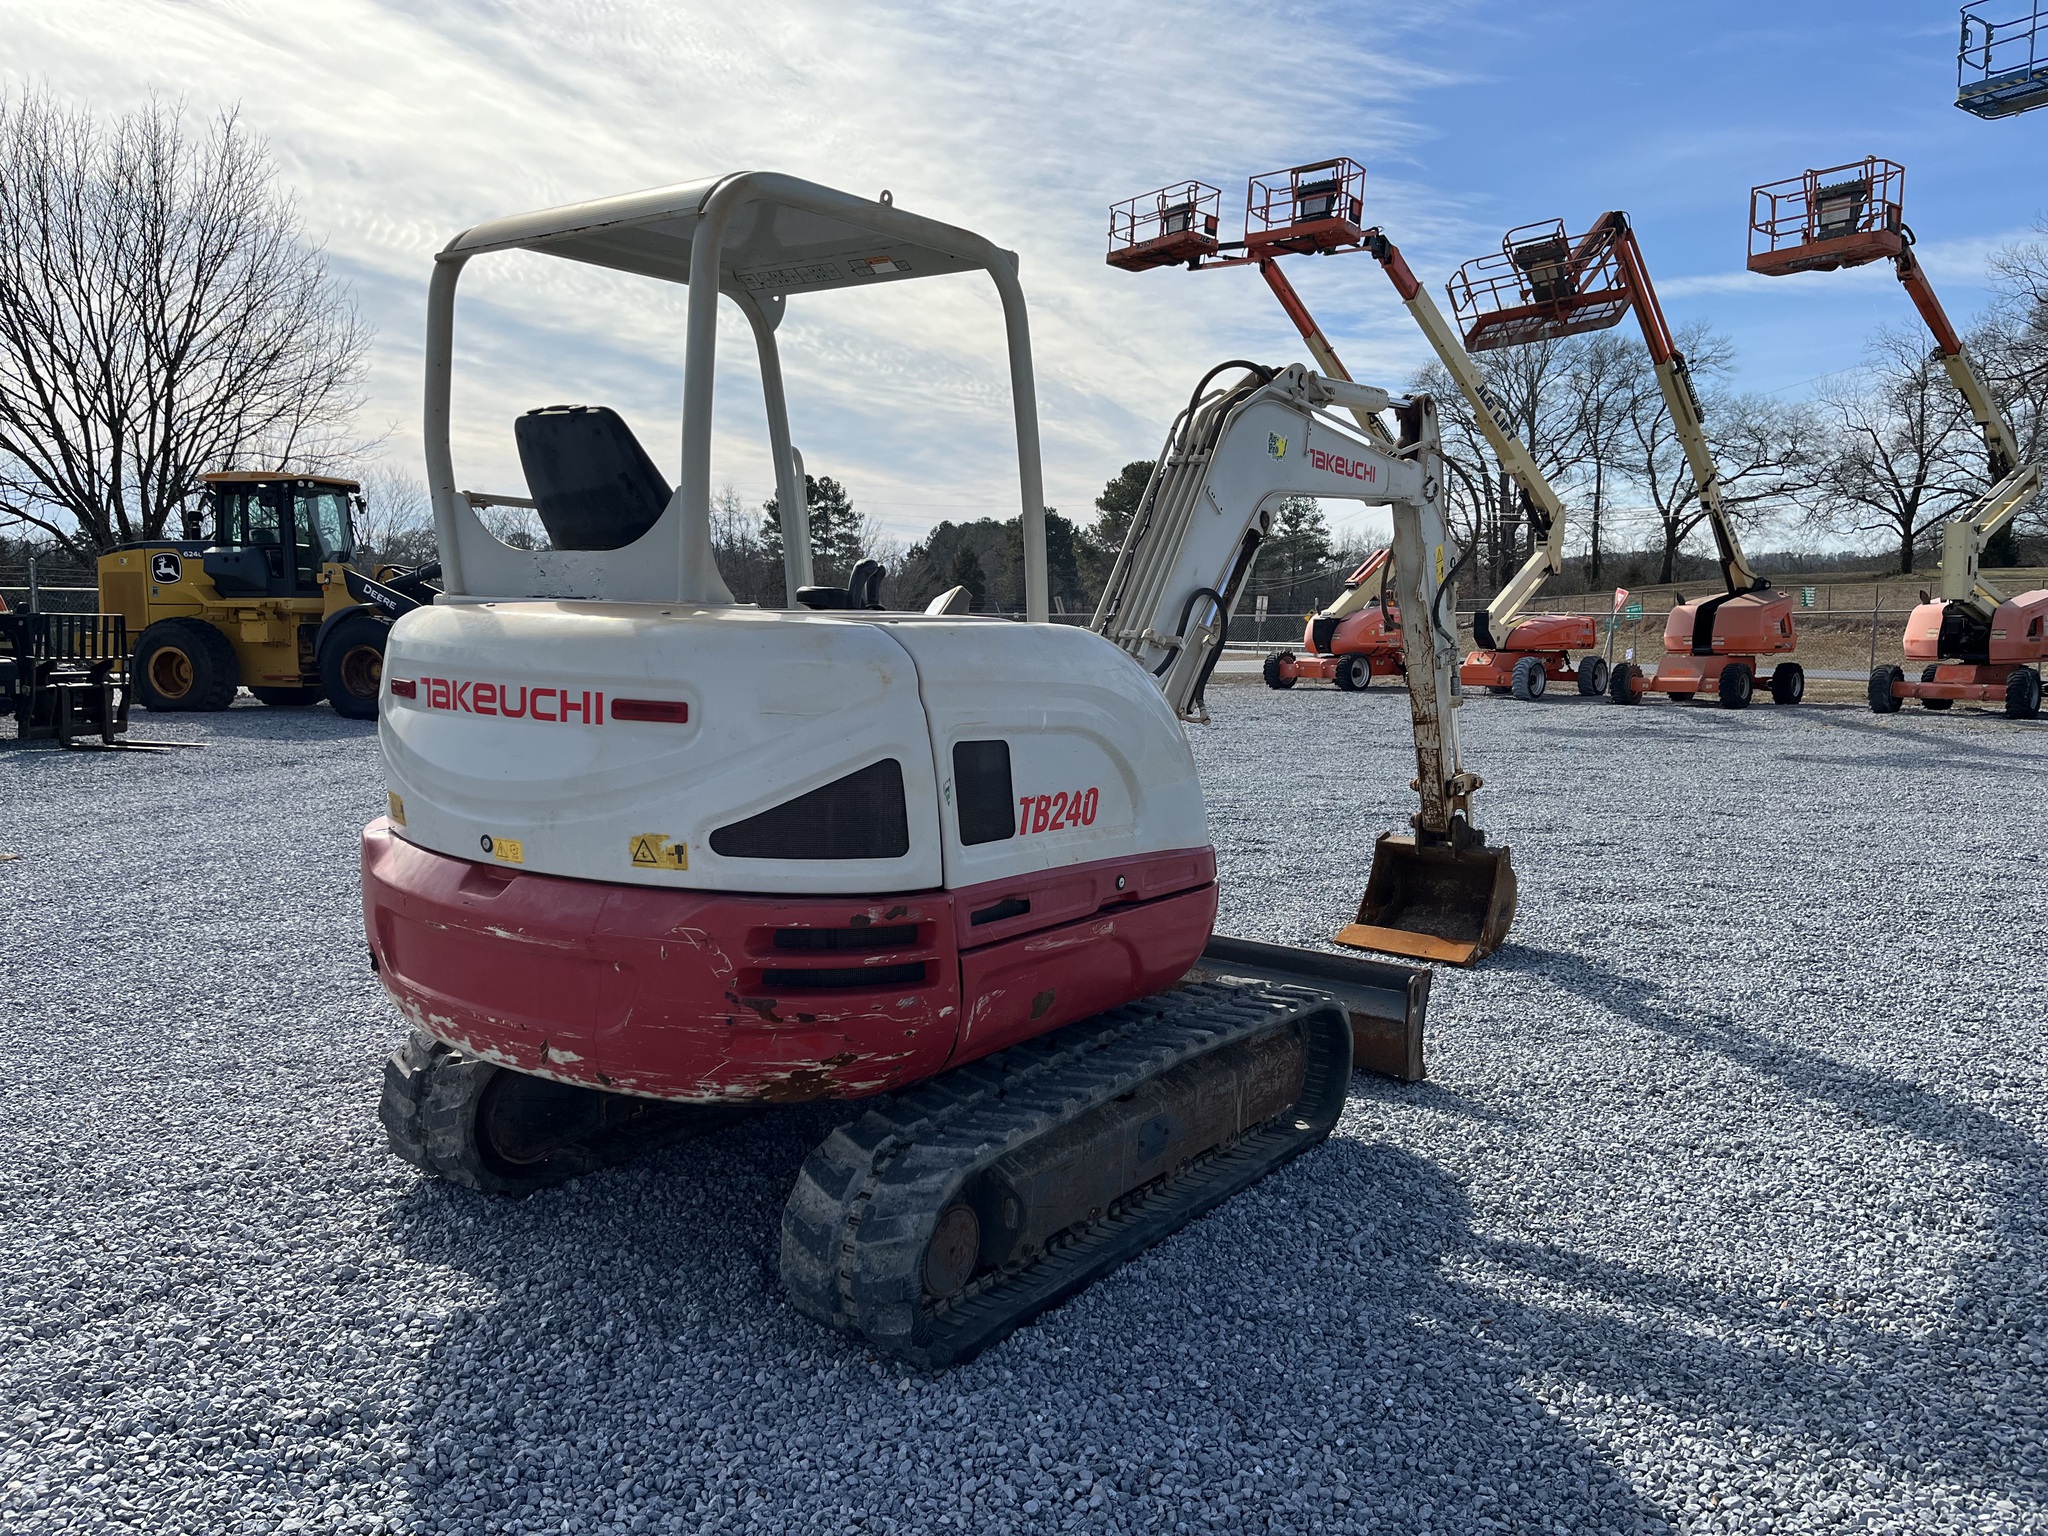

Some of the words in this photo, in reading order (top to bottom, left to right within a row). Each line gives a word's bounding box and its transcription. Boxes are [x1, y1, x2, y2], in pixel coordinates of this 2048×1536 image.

[1475, 384, 1496, 411] JLG
[1493, 410, 1516, 442] LIFT
[363, 583, 397, 611] DEERE
[1019, 787, 1099, 836] TB240
